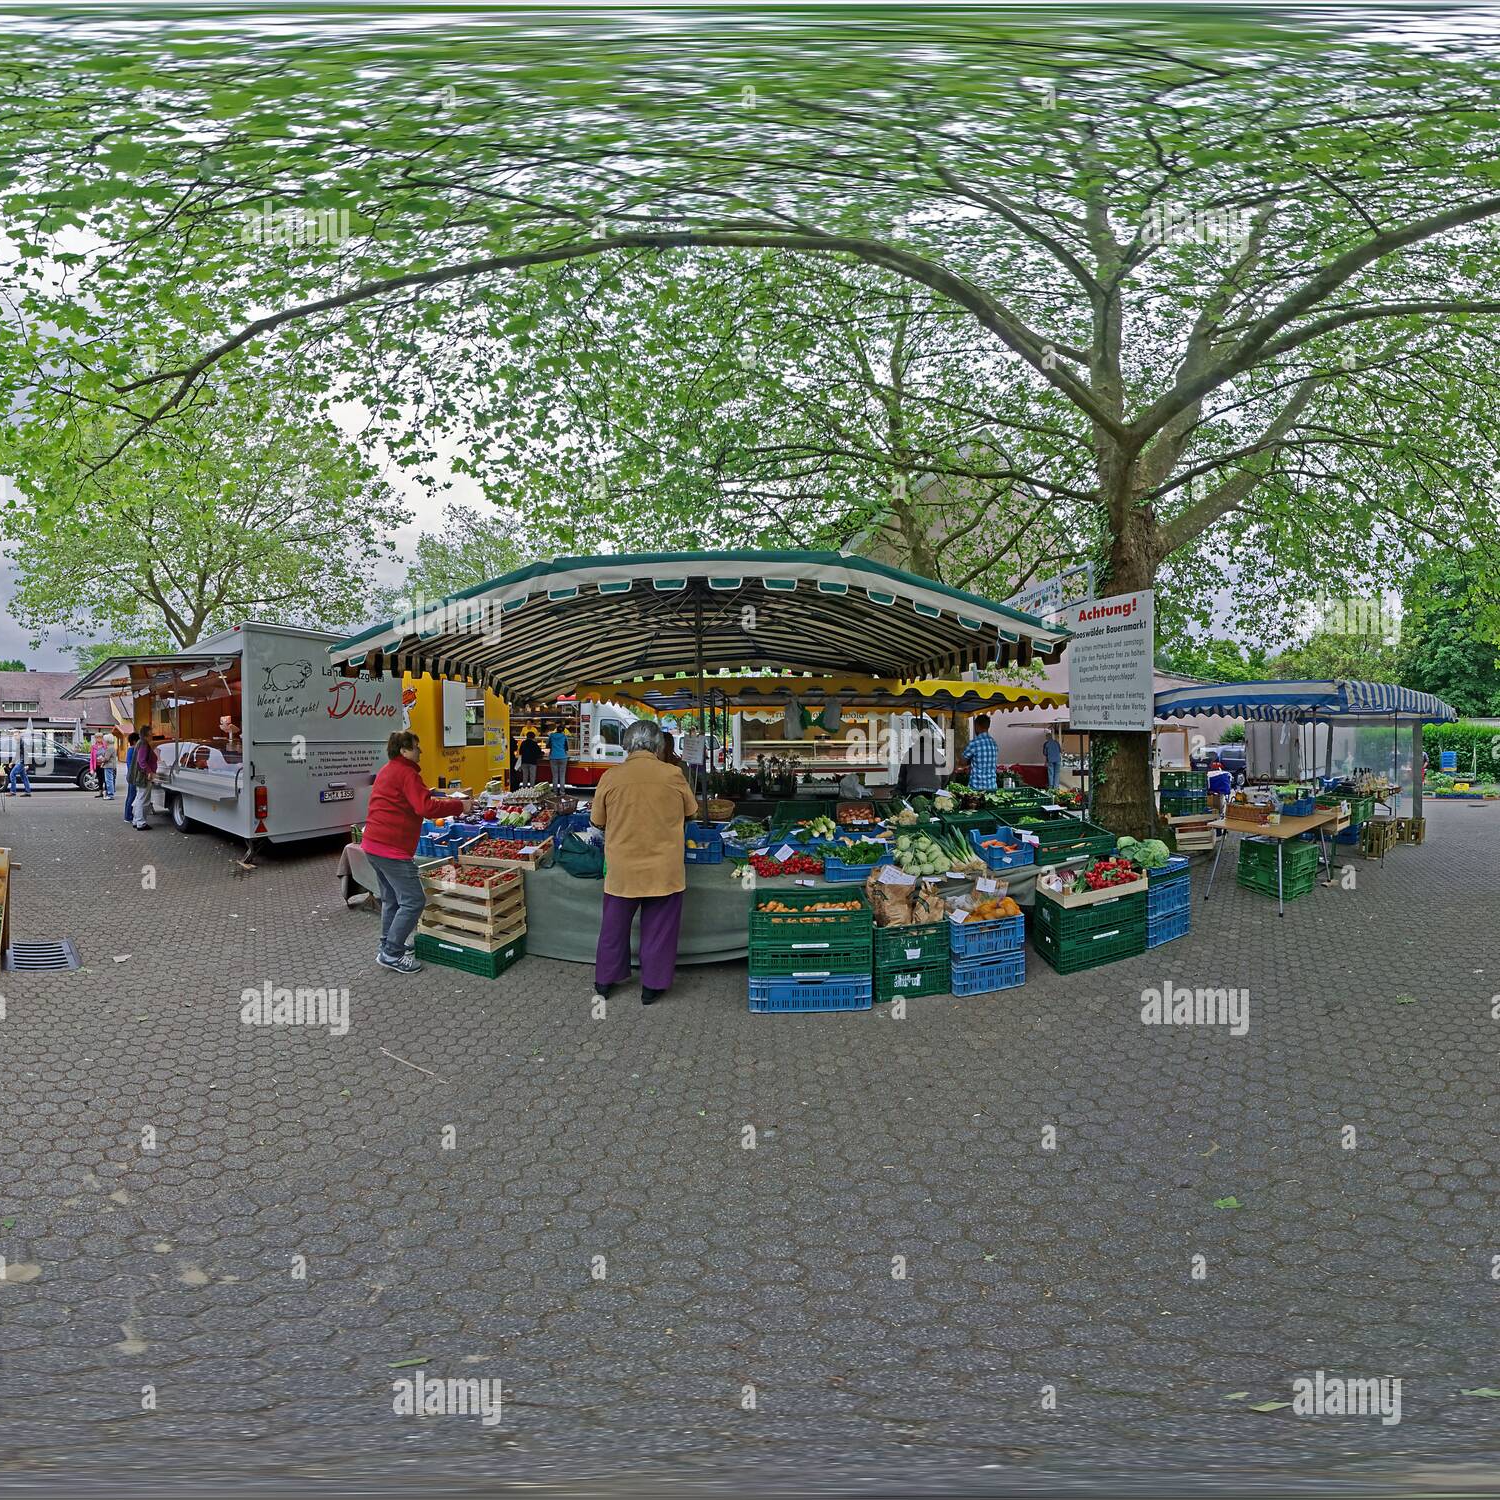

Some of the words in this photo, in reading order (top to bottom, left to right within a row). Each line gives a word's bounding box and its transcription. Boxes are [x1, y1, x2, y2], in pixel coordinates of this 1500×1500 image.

[1079, 598, 1137, 622] Achtung!
[1107, 620, 1147, 633] Bauernmarkt
[1100, 662, 1120, 671] Fahrzeuge
[327, 682, 397, 720] Ditolve
[264, 707, 274, 718] die
[277, 704, 299, 718] Wurst
